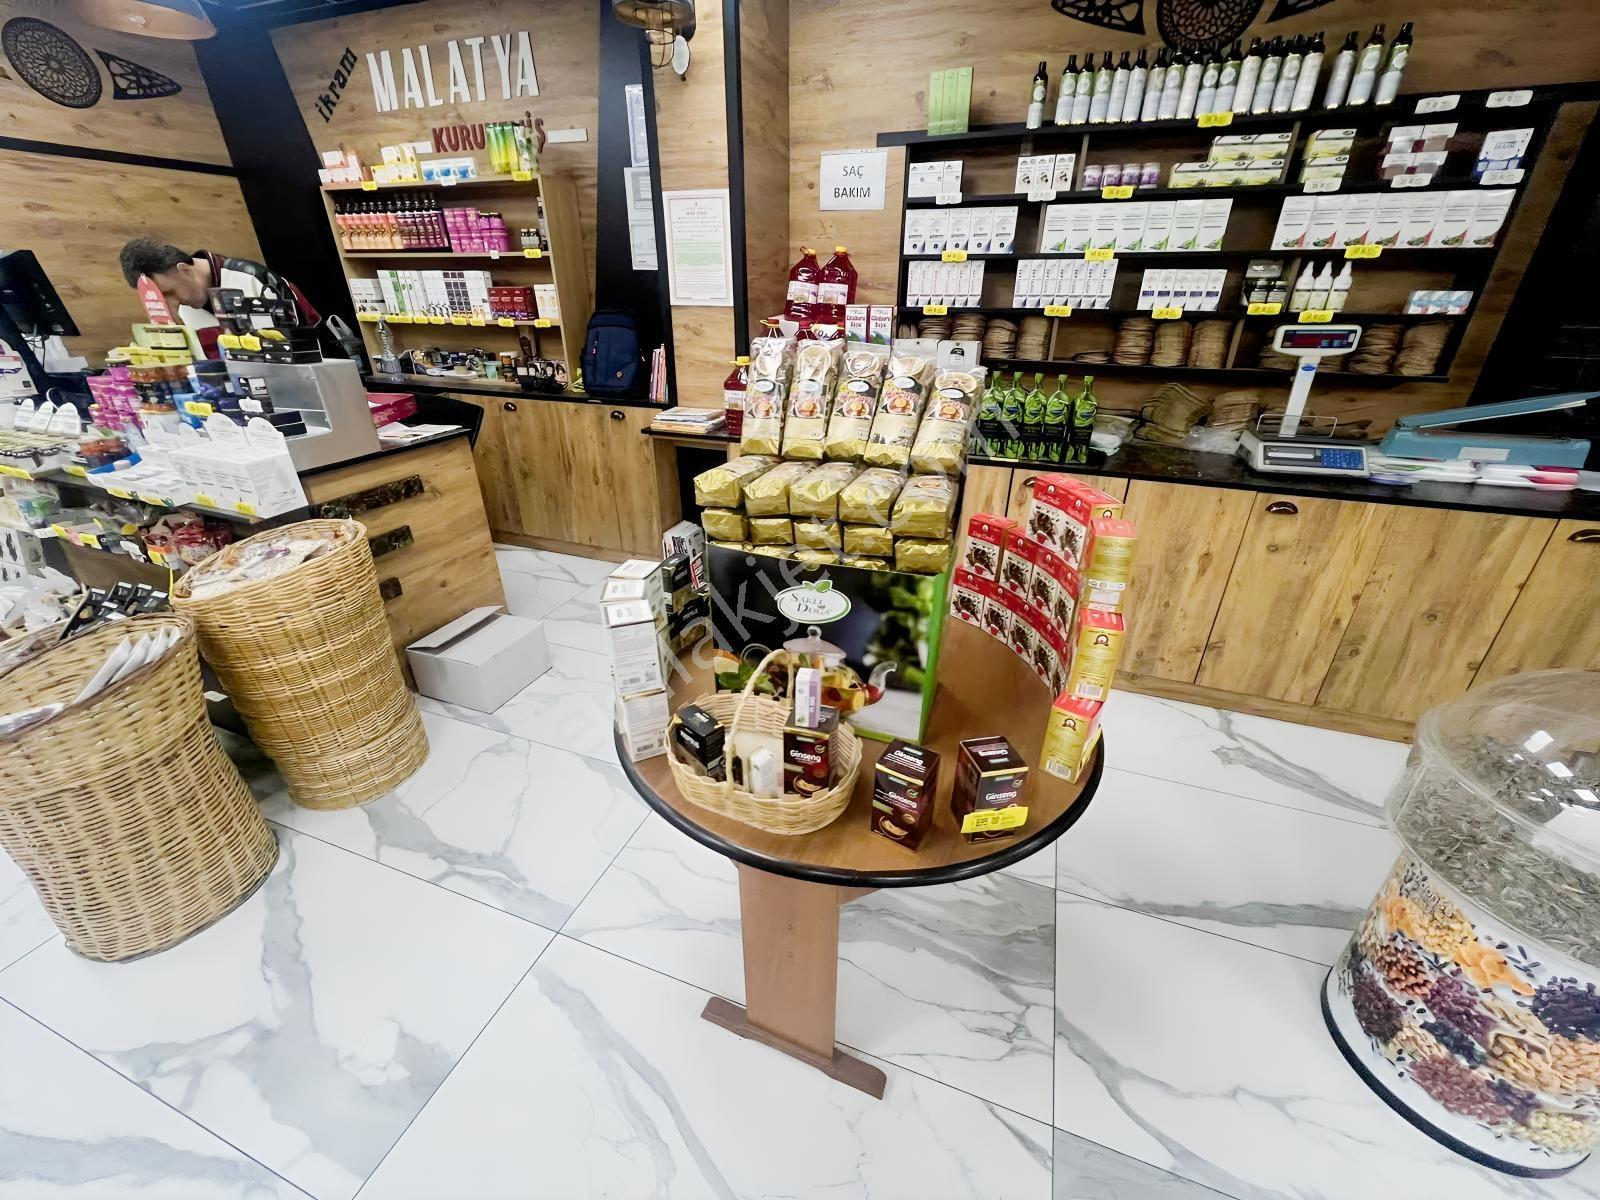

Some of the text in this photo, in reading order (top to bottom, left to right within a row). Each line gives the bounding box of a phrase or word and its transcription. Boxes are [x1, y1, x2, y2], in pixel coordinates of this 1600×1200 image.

[366, 31, 540, 112] MALATYA
[314, 47, 358, 123] ikram
[842, 165, 864, 179] SAÇ
[833, 187, 871, 198] BAKIM
[789, 749, 822, 763] Ginseng
